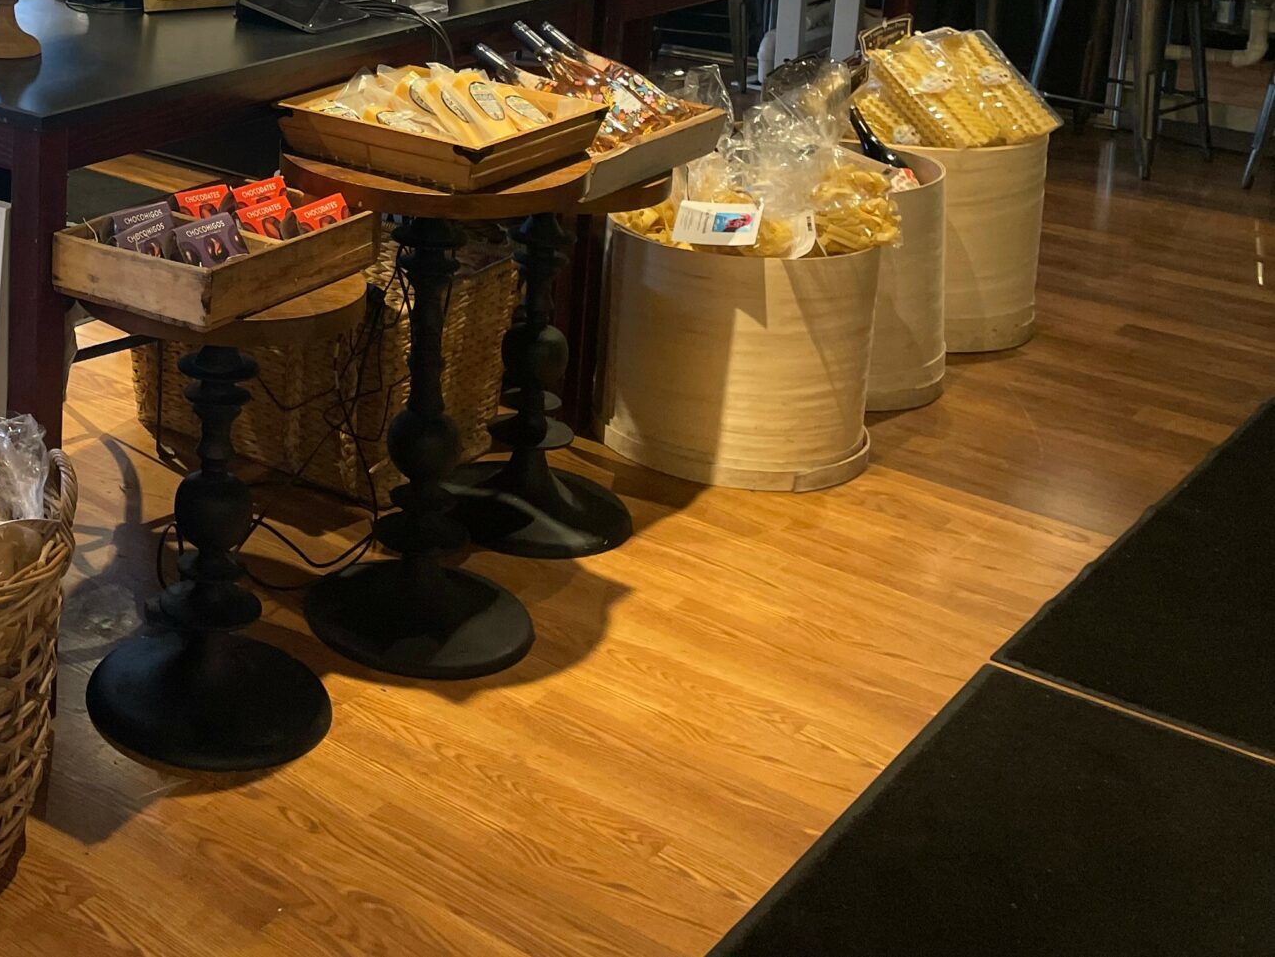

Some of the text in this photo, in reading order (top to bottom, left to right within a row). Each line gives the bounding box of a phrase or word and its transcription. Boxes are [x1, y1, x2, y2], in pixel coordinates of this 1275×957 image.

[184, 190, 221, 204] CHOCODATES
[241, 182, 276, 199] CHOCODATES
[123, 208, 164, 226] CHOCOHIGOS
[245, 202, 282, 220] CHOCODATES
[303, 201, 338, 220] CHOCODATES
[184, 220, 226, 239] CHOCOHIGOS
